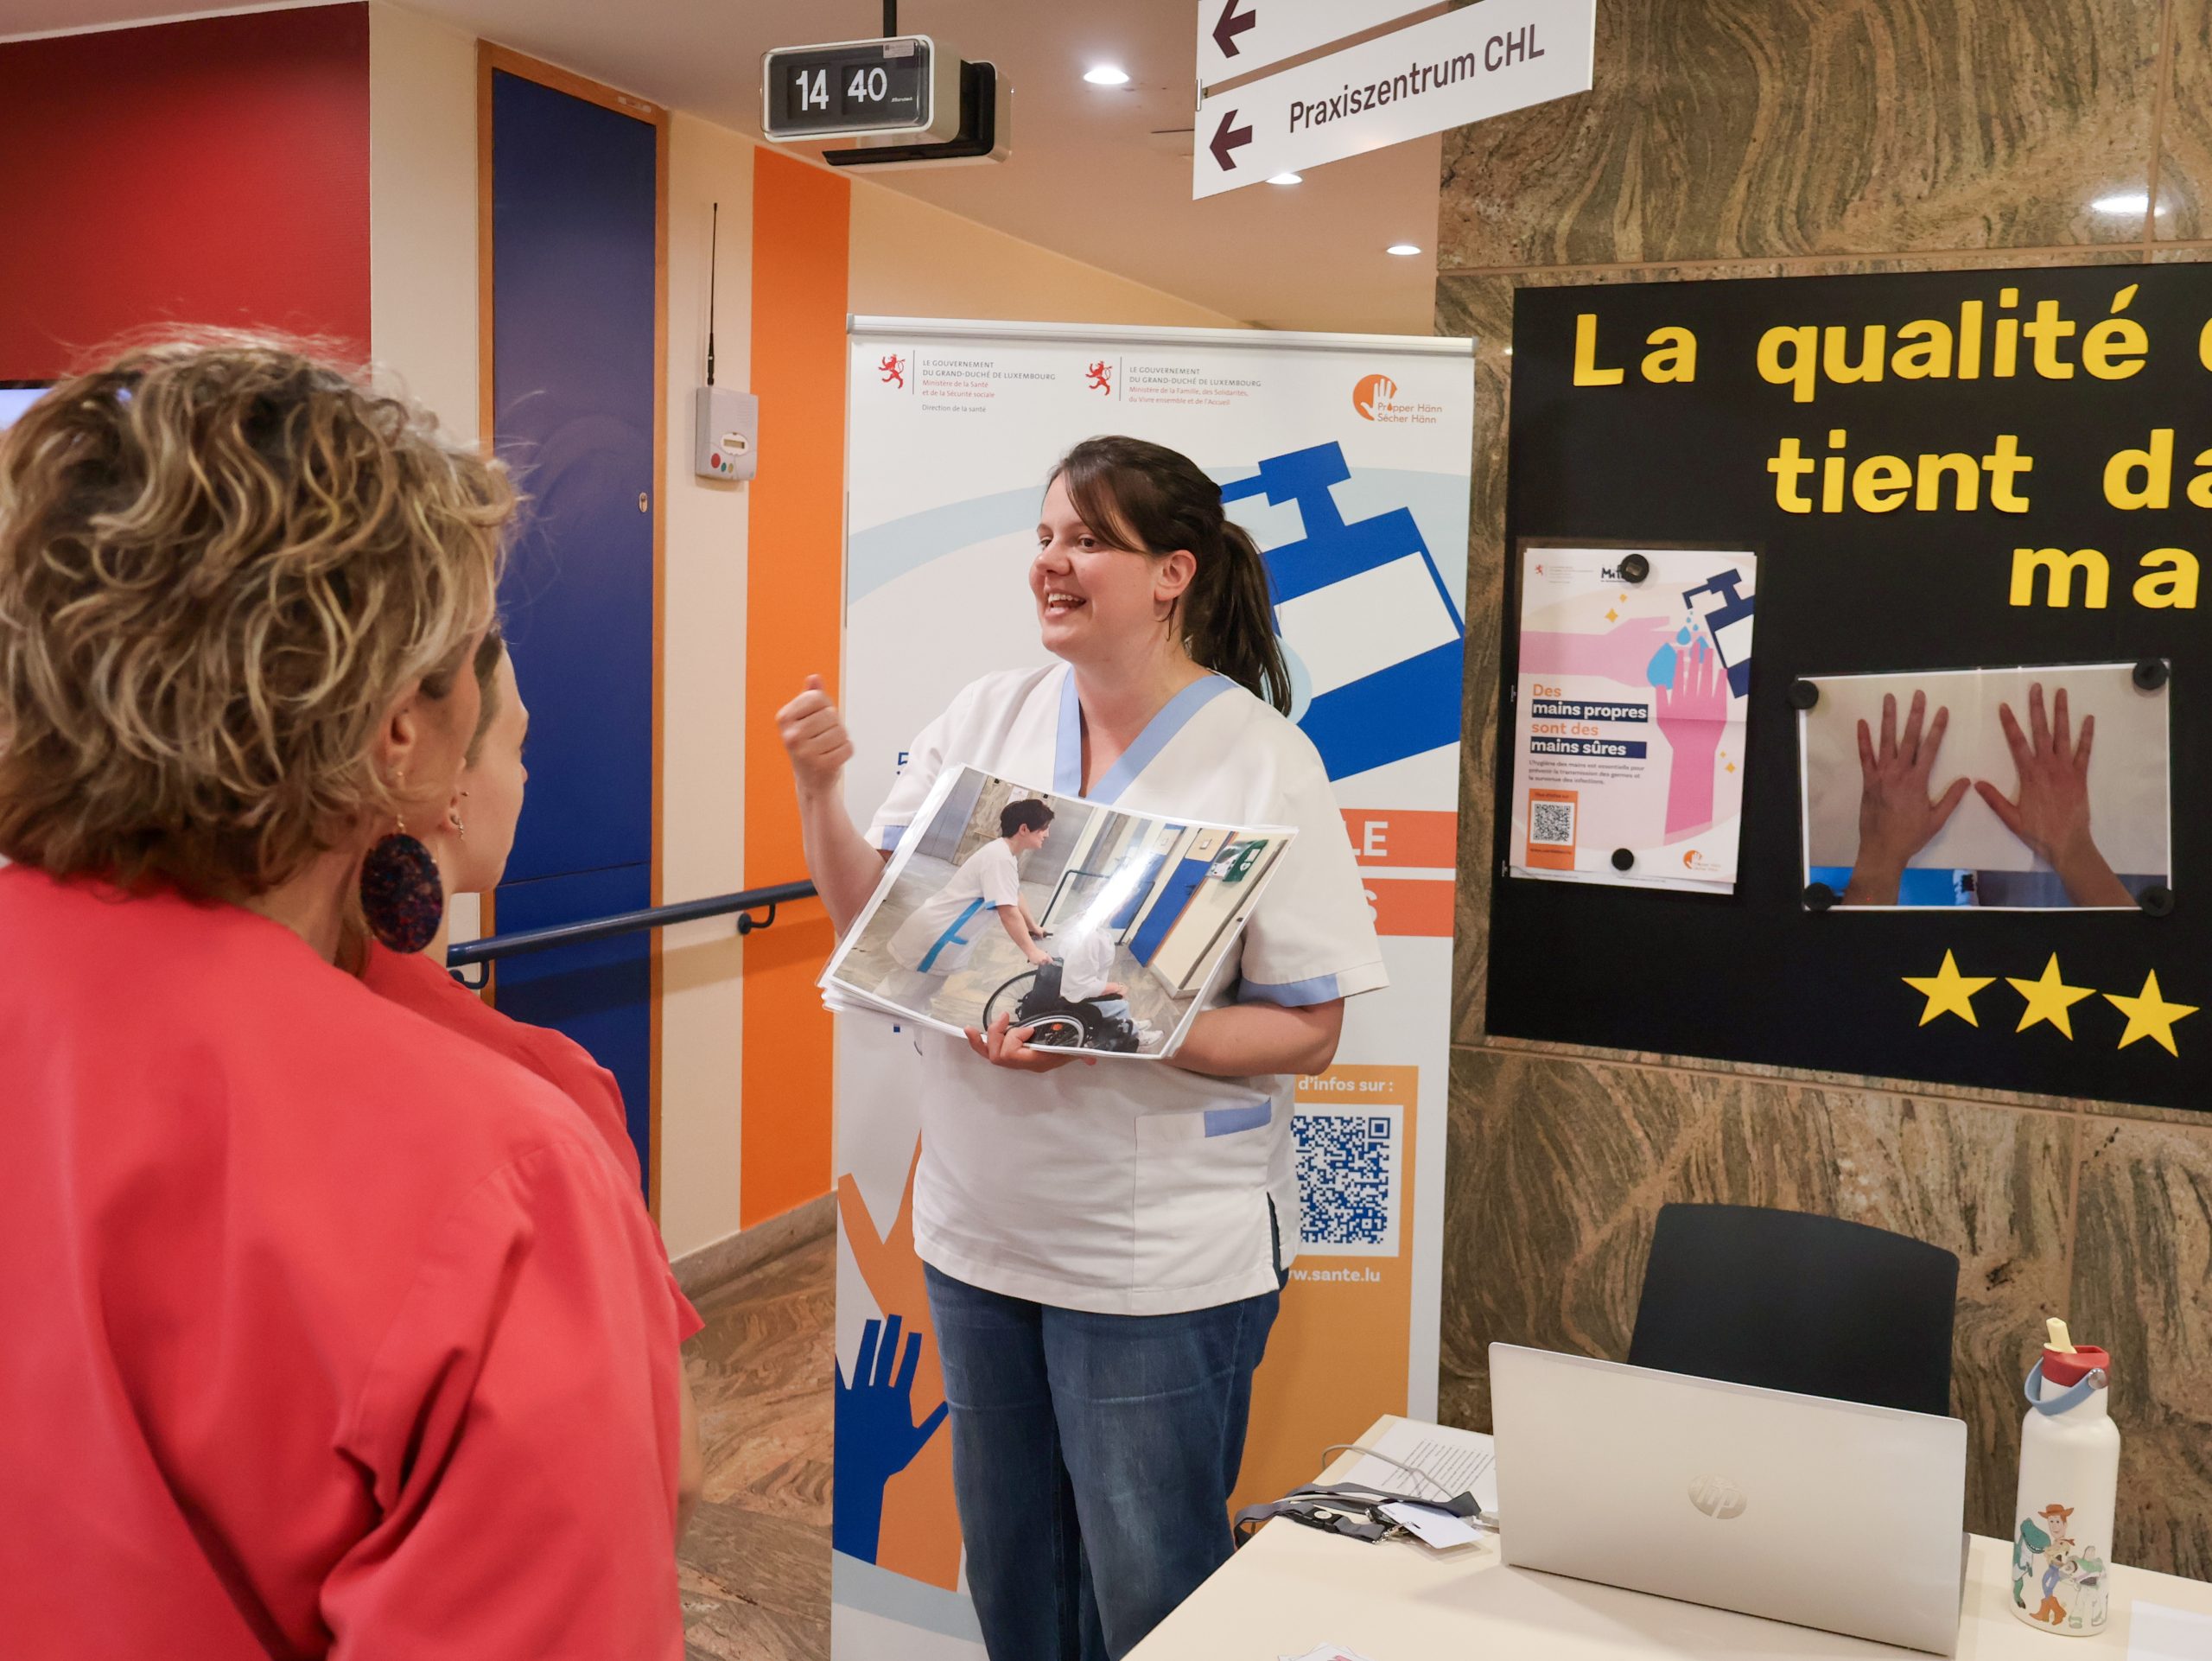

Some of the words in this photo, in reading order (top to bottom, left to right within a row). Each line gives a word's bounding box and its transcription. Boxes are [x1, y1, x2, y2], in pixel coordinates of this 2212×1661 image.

[796, 69, 829, 111] 14
[848, 67, 887, 102] 40
[1290, 52, 1475, 133] Praxiszentrum
[1484, 24, 1545, 72] CHL
[1573, 314, 1697, 386] La
[1756, 283, 2149, 402] qualité
[1767, 429, 2033, 513] tient
[2009, 548, 2200, 608] ma
[1533, 684, 1561, 697] Des
[1531, 723, 1566, 735] sont
[1571, 722, 1599, 735] des
[1533, 702, 1580, 716] mains
[1584, 705, 1647, 721] propres
[1531, 738, 1579, 753] mains
[1582, 741, 1627, 756] sûres
[1344, 820, 1389, 856] E
[1299, 1076, 1355, 1091] d'infos
[1359, 1081, 1386, 1091] sur
